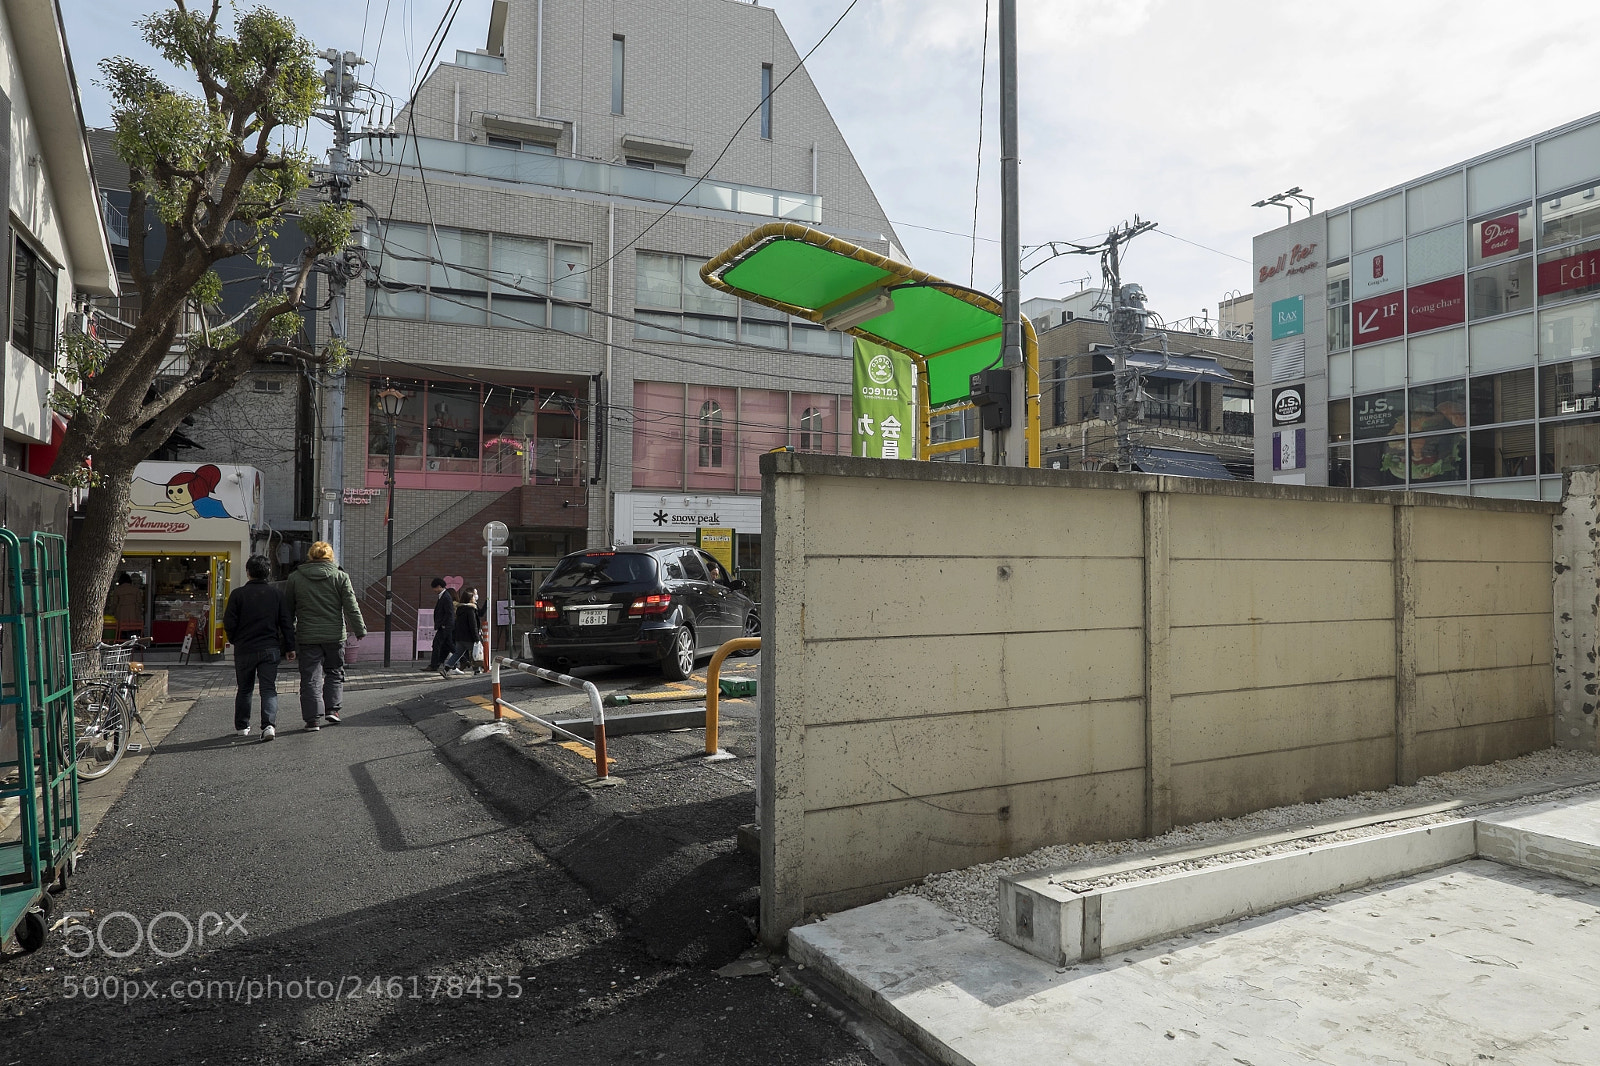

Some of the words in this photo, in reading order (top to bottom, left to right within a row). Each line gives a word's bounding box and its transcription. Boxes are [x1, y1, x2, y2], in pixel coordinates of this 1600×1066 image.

[1259, 254, 1287, 282] Bell
[1290, 244, 1317, 265] Pier
[1383, 303, 1399, 318] 1F
[1411, 304, 1436, 314] Gong
[1436, 298, 1453, 309] cha
[1279, 398, 1299, 408] J.S.
[1359, 398, 1394, 415] J.S.
[1561, 396, 1600, 414] LIF
[1359, 412, 1392, 421] BURGERS
[671, 514, 697, 522] snow
[697, 512, 720, 525] peak
